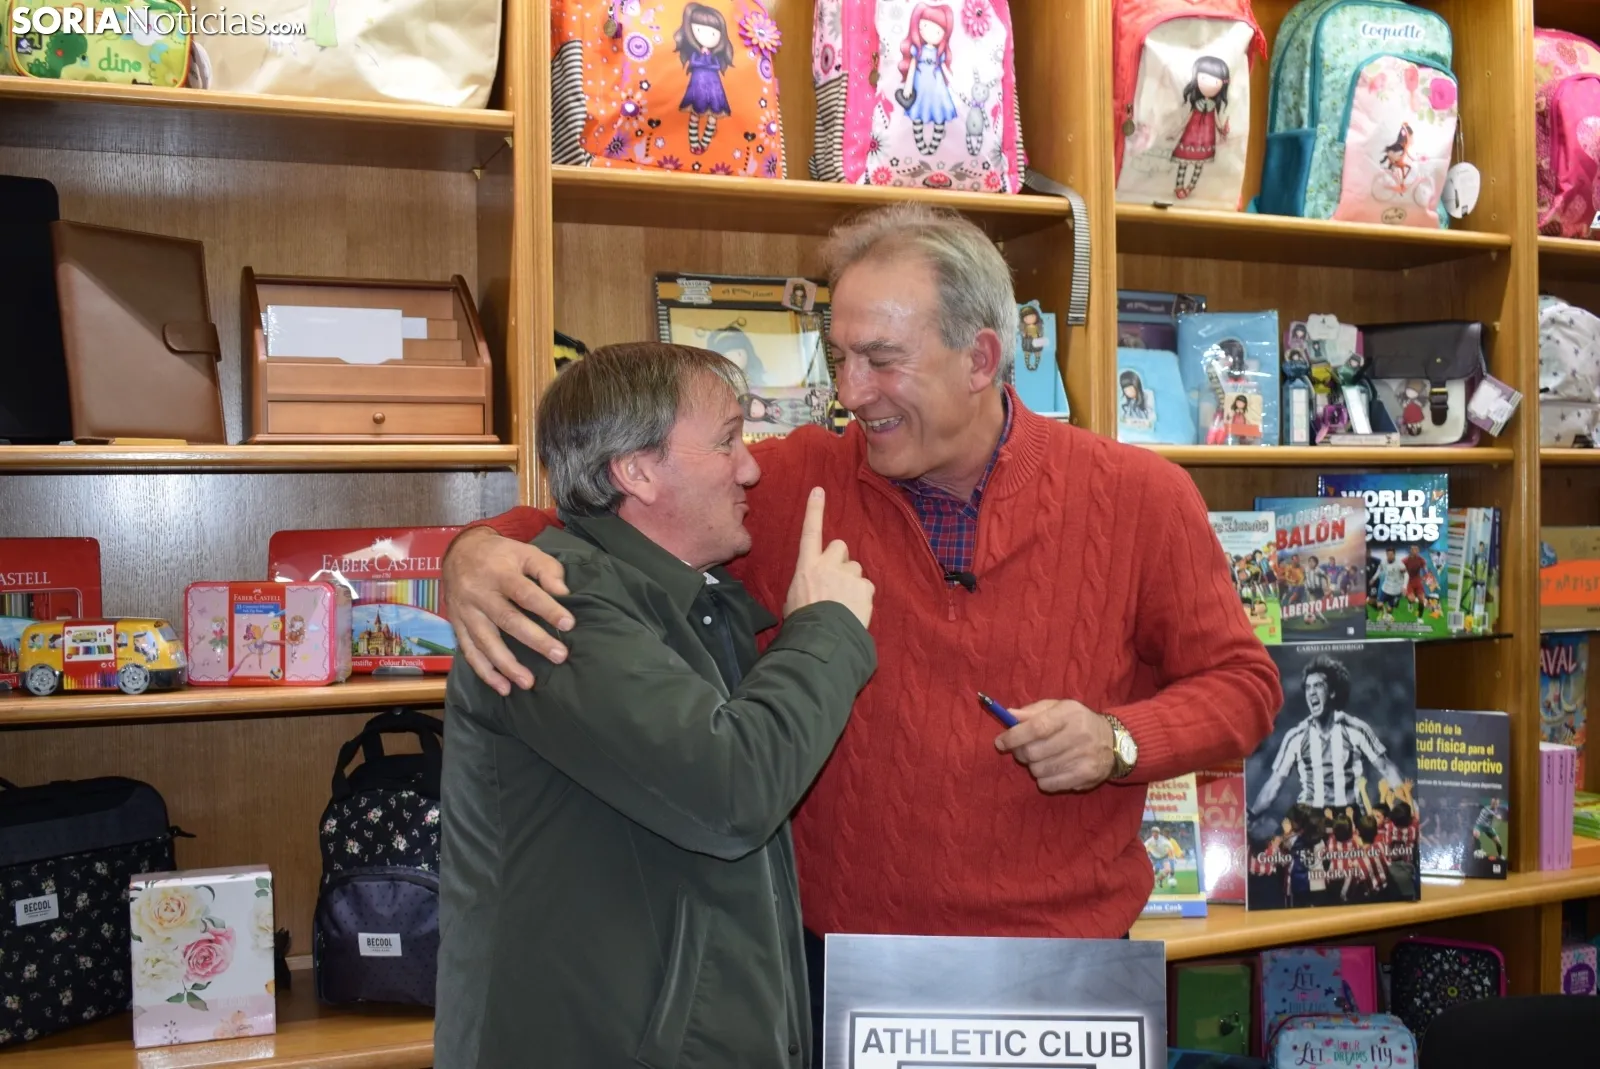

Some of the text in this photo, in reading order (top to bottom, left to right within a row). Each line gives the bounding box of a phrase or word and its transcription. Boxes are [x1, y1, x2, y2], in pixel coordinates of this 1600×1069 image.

[98, 47, 143, 72] dino
[1276, 515, 1346, 551] BALÓN
[321, 553, 443, 573] FABER-CASTELL
[1296, 643, 1364, 653] CARMELO RODRIGO
[378, 659, 400, 667] Colour
[401, 659, 424, 667] Pencils
[1443, 725, 1453, 735] de
[1454, 724, 1462, 736] la
[1468, 745, 1485, 756] para
[1486, 744, 1495, 756] el
[1450, 756, 1503, 775] deportivo
[1204, 783, 1239, 806] LA
[1257, 852, 1293, 864] Goiko
[1317, 848, 1366, 861] Corazón
[1367, 847, 1382, 856] de
[1384, 845, 1414, 856] León
[1307, 869, 1366, 881] BIOGRAFÍA
[23, 900, 52, 914] BECOOL
[1164, 902, 1183, 911] Cook
[366, 937, 393, 947] BECOOL
[861, 1027, 1133, 1058] ATHLETIC CLUB
[1295, 1040, 1325, 1067] LET
